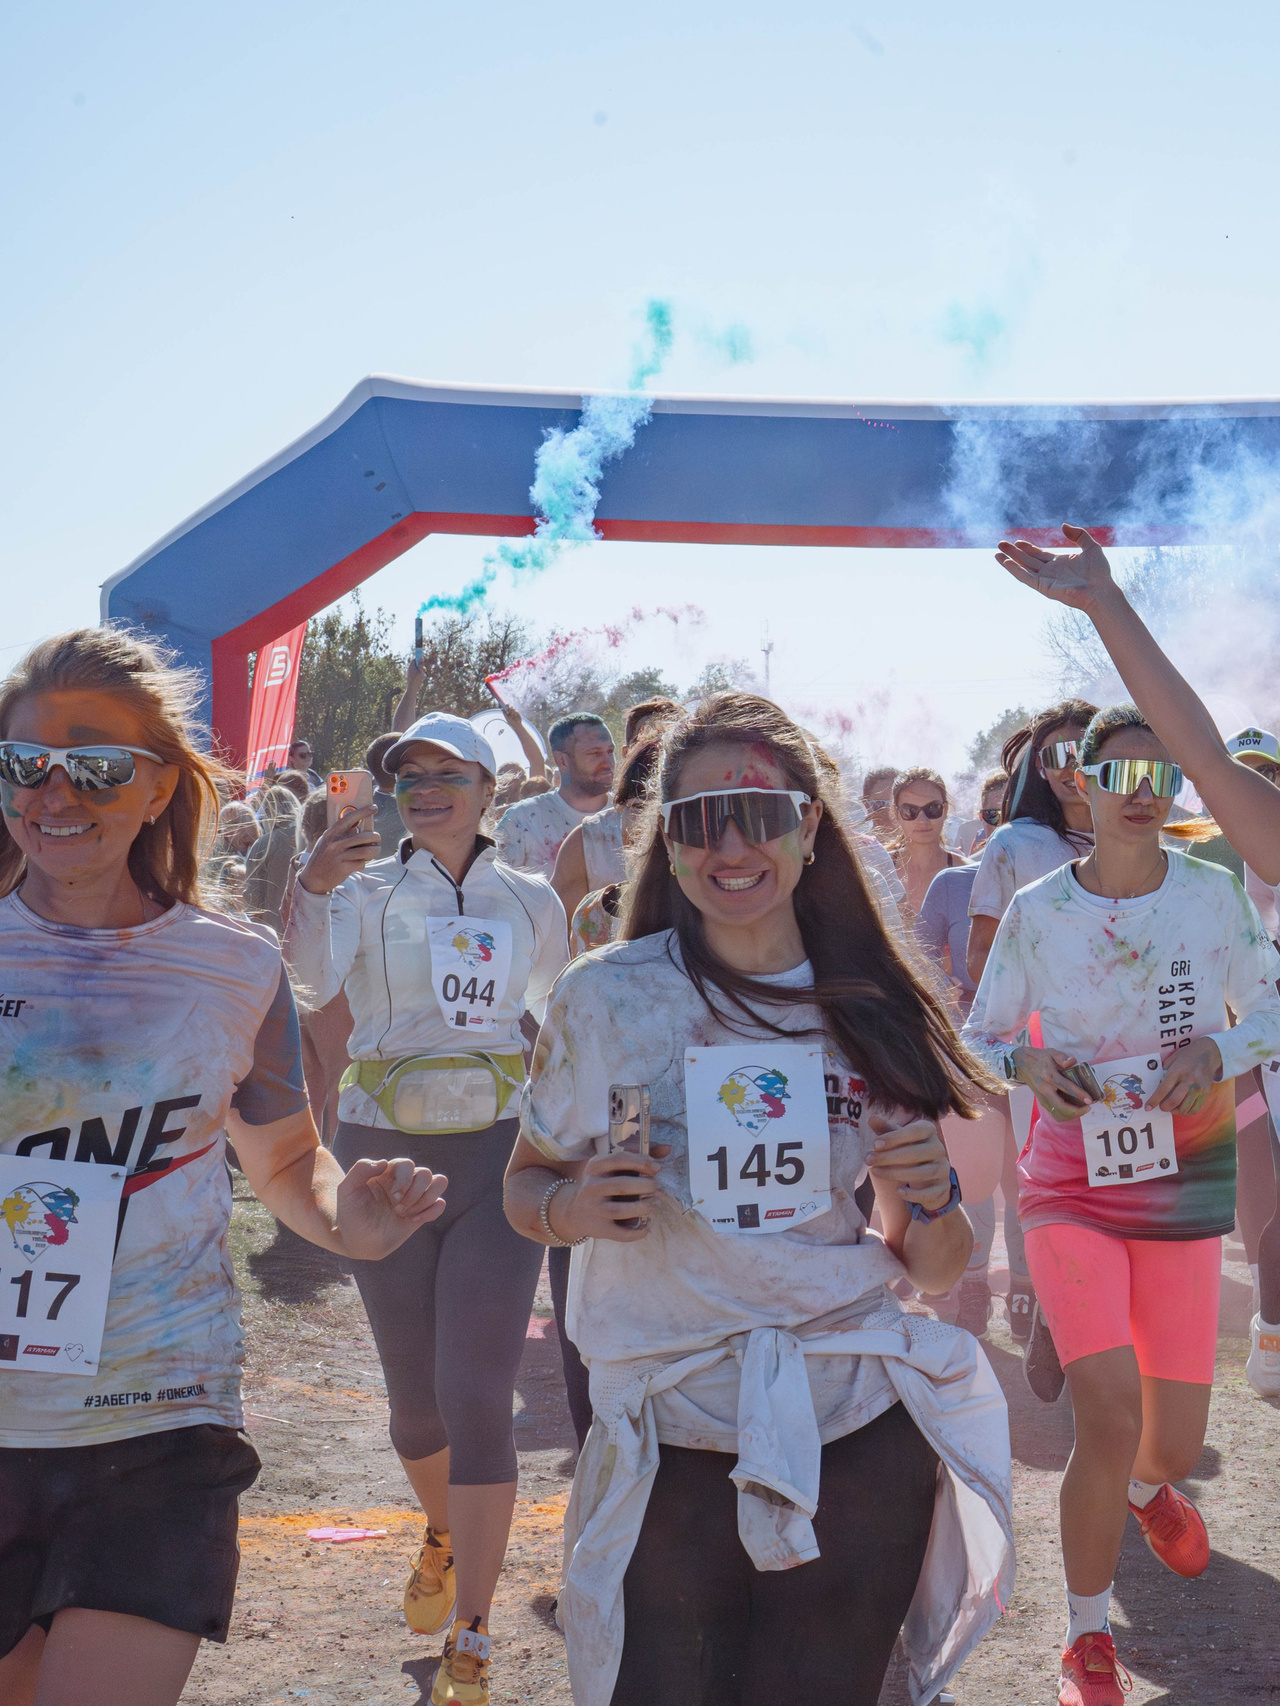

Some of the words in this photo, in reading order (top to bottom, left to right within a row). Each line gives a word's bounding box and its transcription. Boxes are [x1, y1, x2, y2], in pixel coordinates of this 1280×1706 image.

[1238, 738, 1261, 748] NOW
[442, 973, 496, 1007] 044
[1158, 984, 1177, 1050] ЗАБЕГ
[1096, 1122, 1155, 1157] 101
[706, 1141, 805, 1191] 145
[0, 1268, 81, 1321] 17
